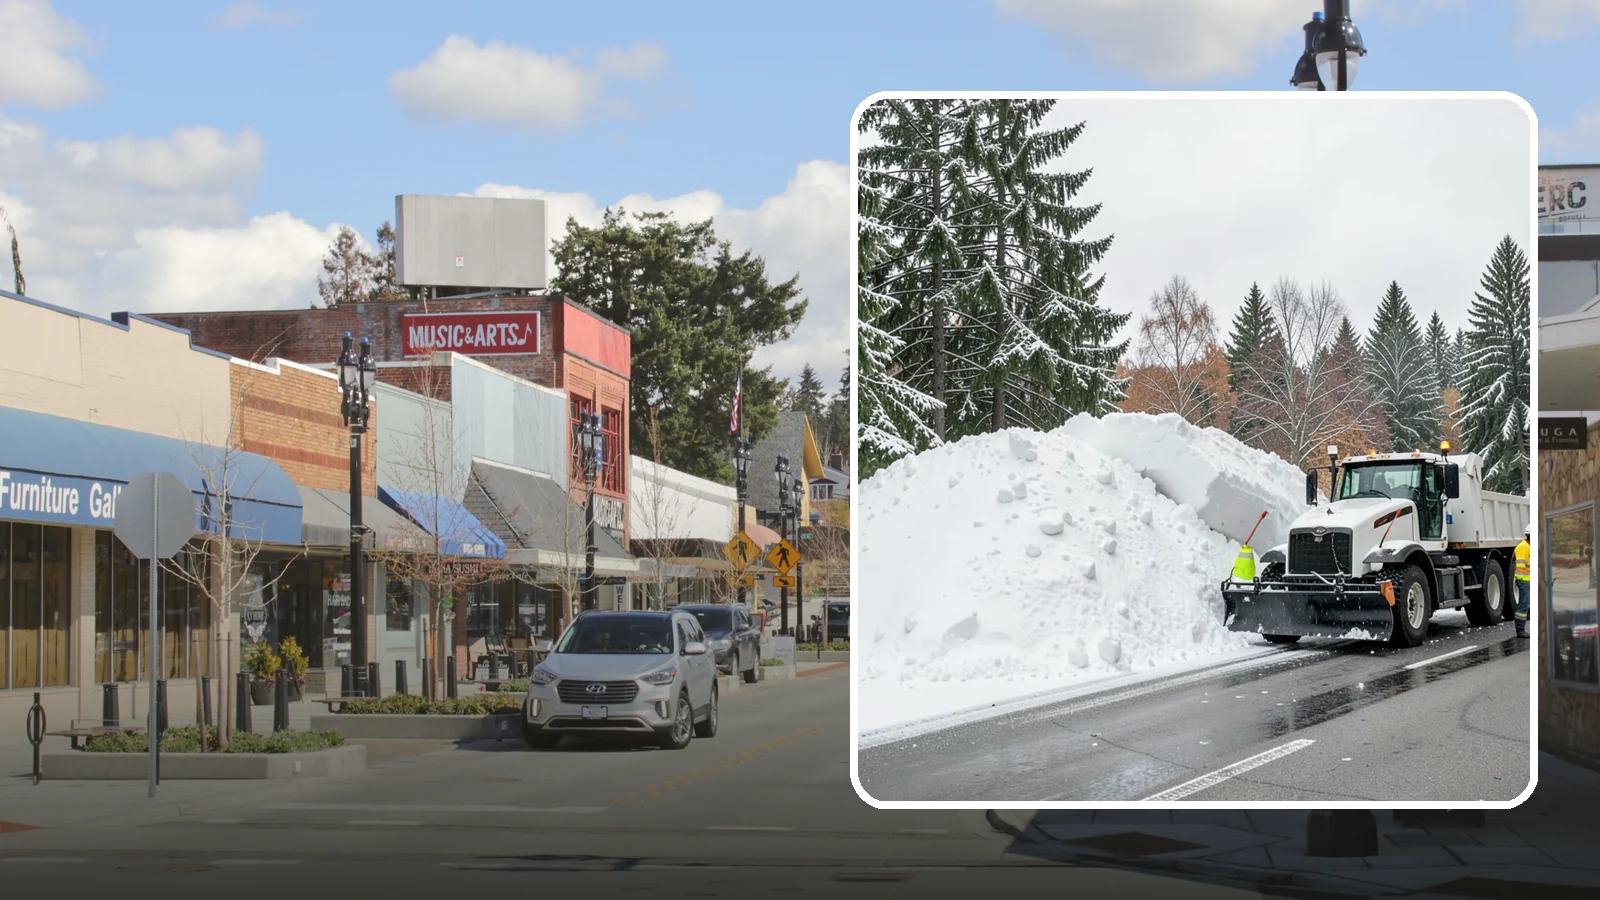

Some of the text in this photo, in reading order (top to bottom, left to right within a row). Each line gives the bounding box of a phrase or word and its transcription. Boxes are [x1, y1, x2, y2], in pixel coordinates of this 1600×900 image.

[0, 472, 122, 519] Furniture Gal
[454, 563, 479, 574] SUSHI
